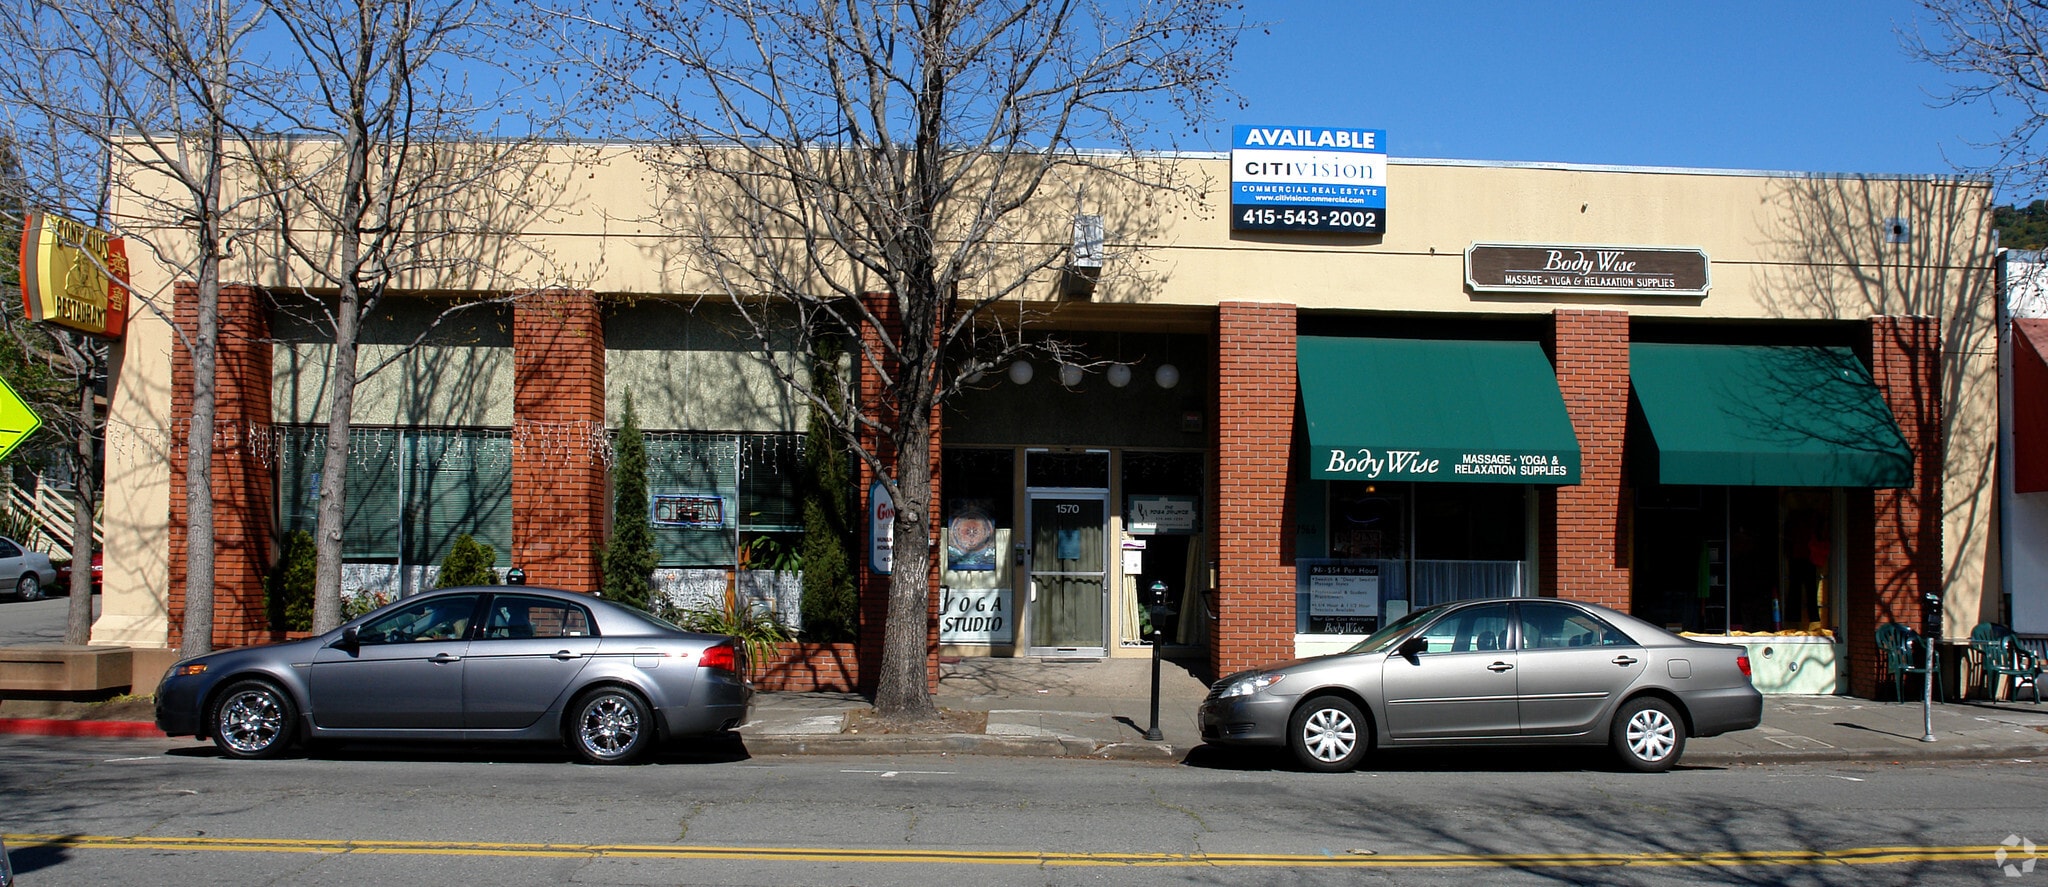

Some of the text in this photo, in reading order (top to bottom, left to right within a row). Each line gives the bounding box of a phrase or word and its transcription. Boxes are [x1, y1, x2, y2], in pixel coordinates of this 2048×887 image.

[1245, 128, 1375, 149] AVAILABLE
[1245, 155, 1373, 179] CITIvision
[1241, 185, 1377, 196] COMMERCIAL REAL ESTATE
[1255, 194, 1365, 204] www.citivisioncommercial.com
[1243, 208, 1376, 228] 415-543-2002
[1504, 274, 1676, 288] MASSAGE YOGA & RELAXATION SUPPLIES
[55, 295, 107, 329] RESTAURANT
[1462, 454, 1559, 465] MASSAGE YOGA &
[1454, 464, 1567, 476] RELAXATION SUPPLIES
[654, 497, 723, 523] OPEN
[1055, 504, 1080, 514] 1570
[1344, 566, 1356, 574] Per
[1359, 566, 1377, 574] Hour
[944, 596, 1003, 613] YOGA
[942, 616, 1003, 633] STUDIO
